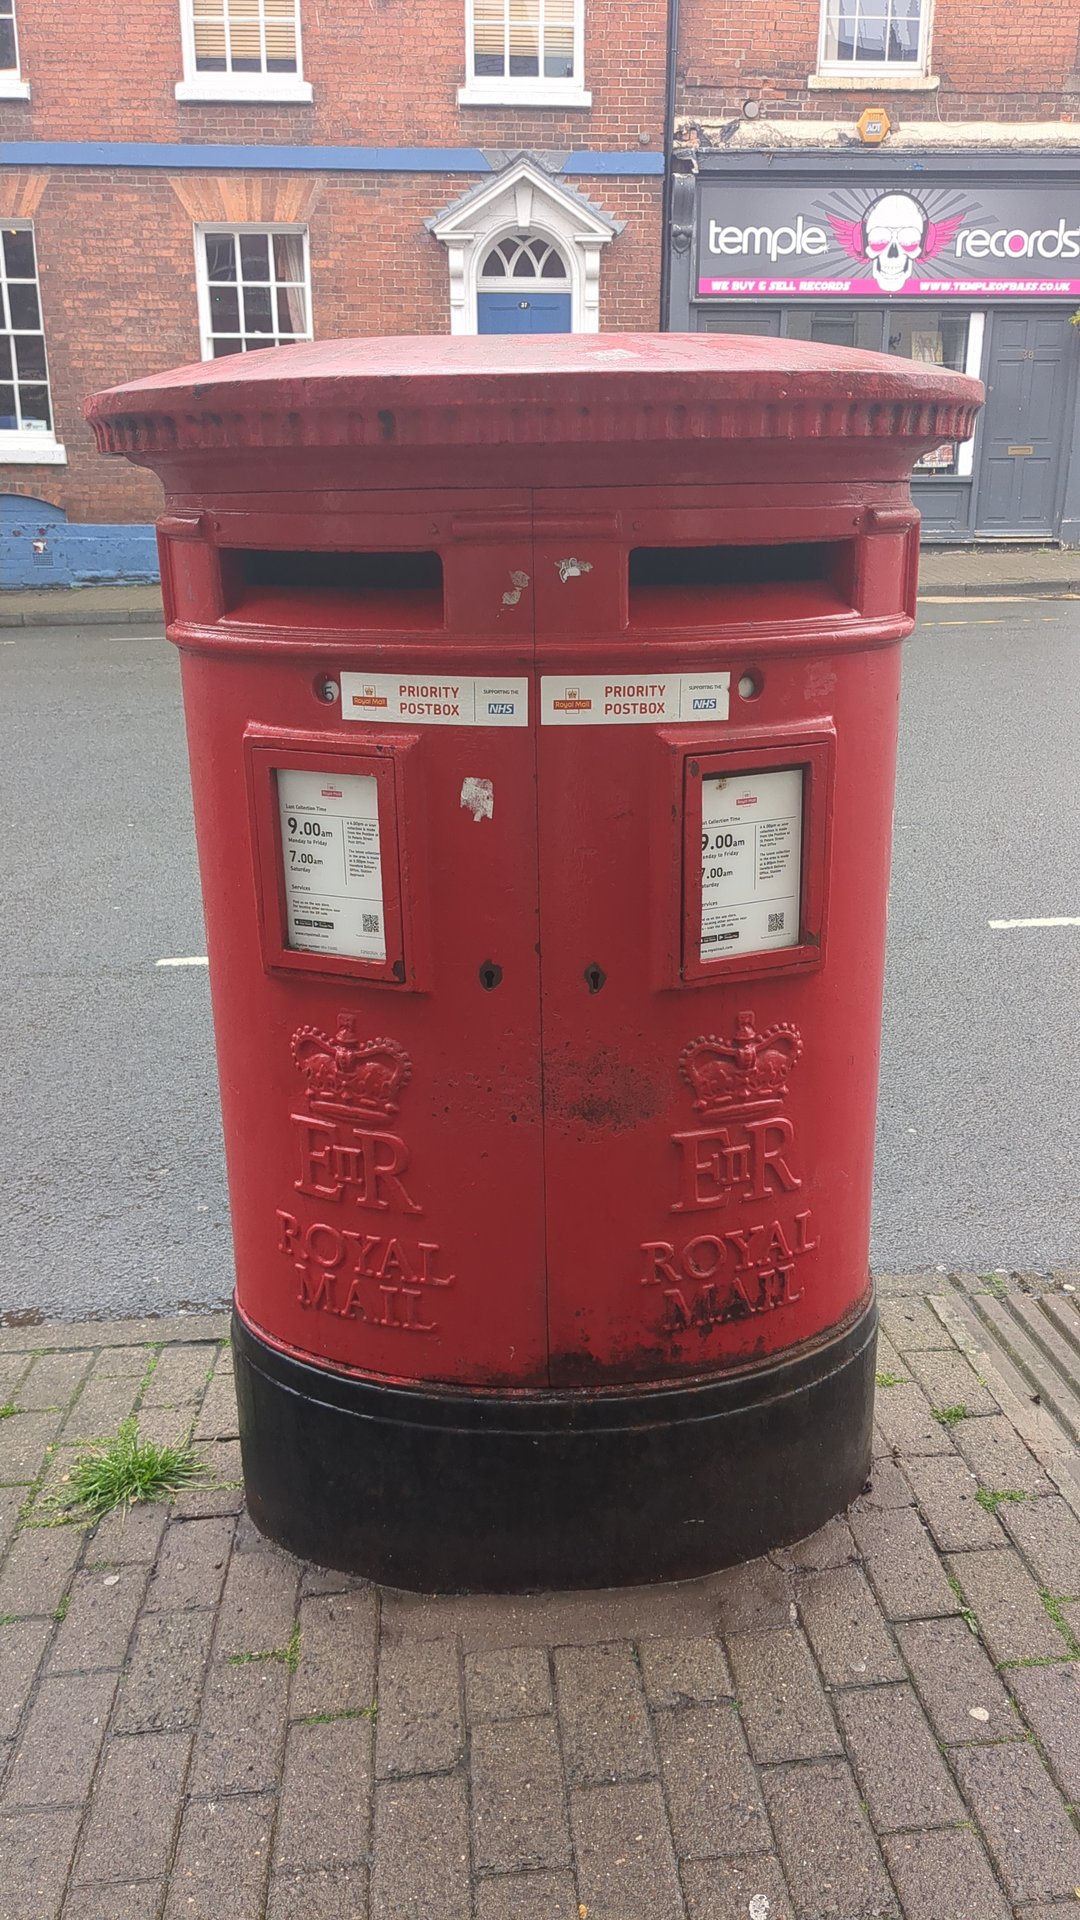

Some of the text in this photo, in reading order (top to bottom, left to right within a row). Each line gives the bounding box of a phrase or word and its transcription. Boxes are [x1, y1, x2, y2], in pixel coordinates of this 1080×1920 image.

[709, 216, 1080, 262] temple records
[711, 281, 729, 291] WE
[732, 281, 755, 291] BUY
[768, 282, 796, 291] SELL
[798, 281, 851, 291] RECORDS
[920, 282, 1070, 291] WWW.TEMPLEOFBASS.CO.UK
[324, 686, 334, 702] 5
[399, 686, 460, 698] PRIORITY
[604, 685, 666, 698] PRIORITY
[354, 697, 371, 706] Royal
[554, 700, 590, 710] Royal Mail
[604, 702, 665, 714] POSTBOX
[694, 699, 716, 709] NHS
[400, 703, 460, 716] POSTBOX
[490, 704, 513, 714] NHS
[288, 817, 332, 838] 9.00am
[289, 850, 324, 864] 7.00am
[276, 1209, 455, 1286] ROYAL
[640, 1210, 822, 1286] ROYAL
[296, 1263, 440, 1332] MAIL
[662, 1264, 805, 1329] MAIL
